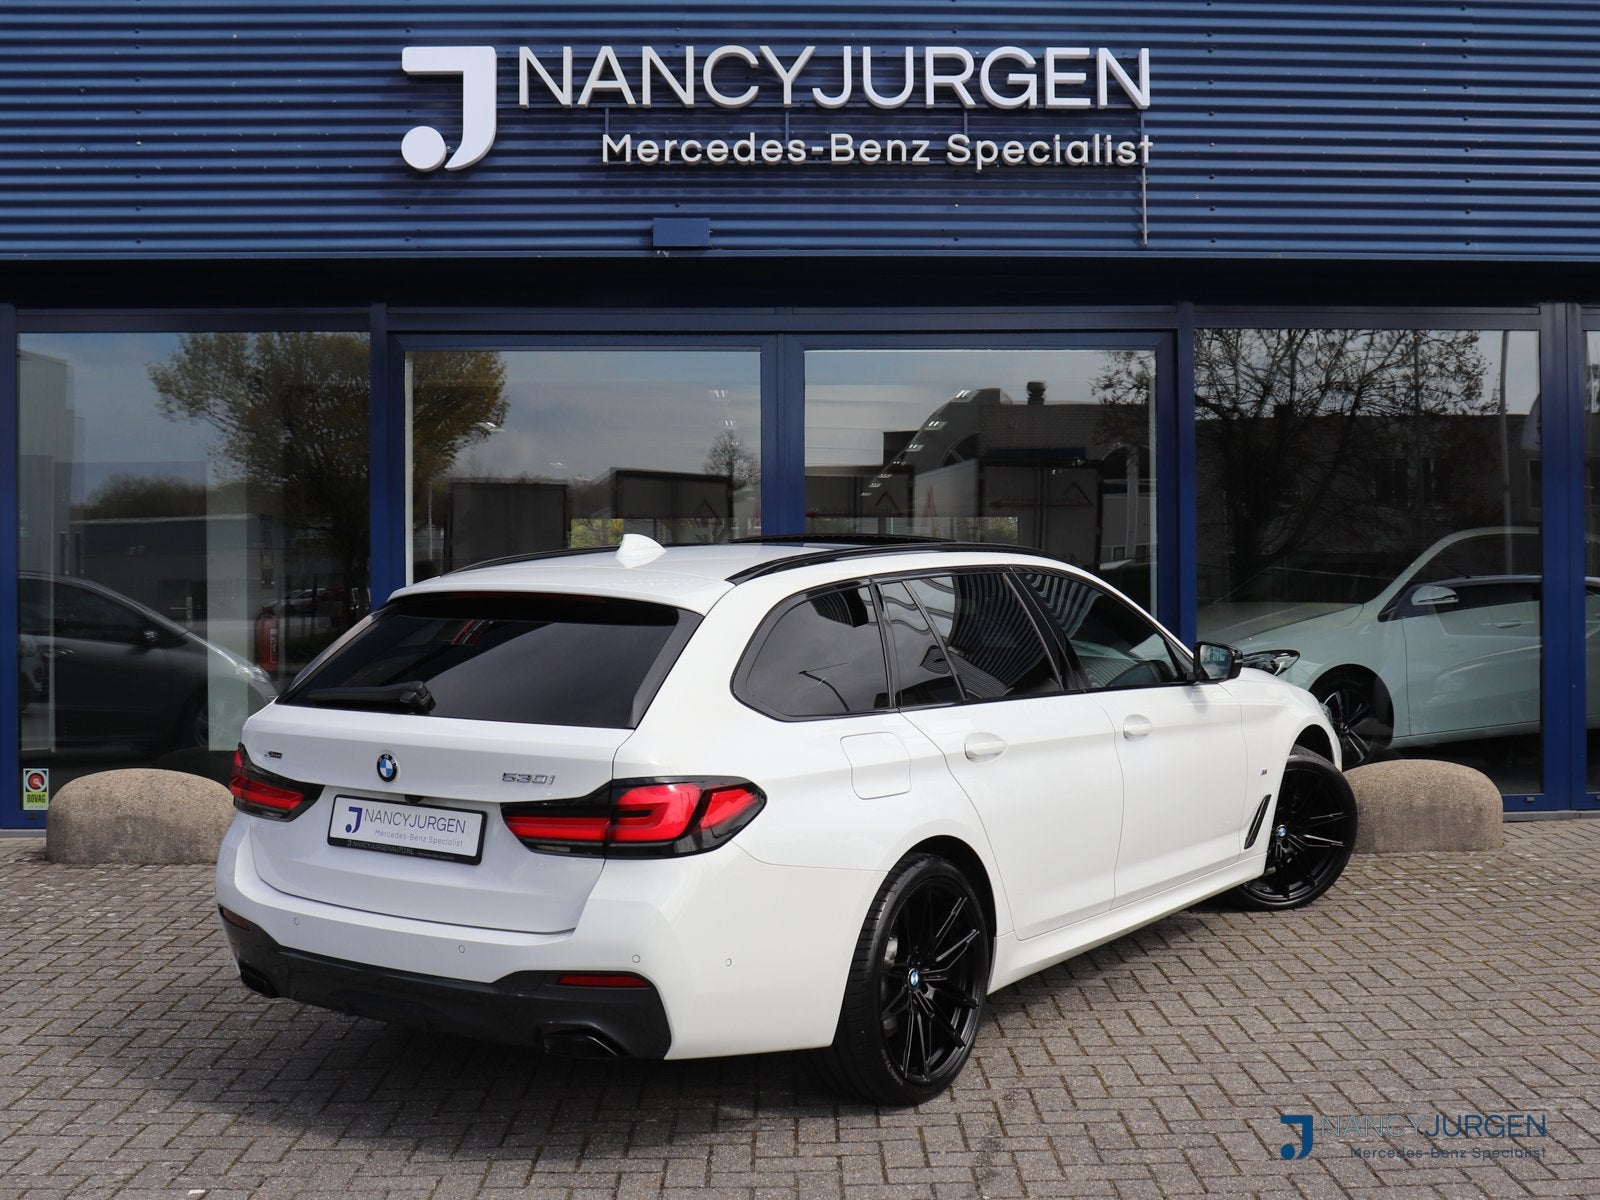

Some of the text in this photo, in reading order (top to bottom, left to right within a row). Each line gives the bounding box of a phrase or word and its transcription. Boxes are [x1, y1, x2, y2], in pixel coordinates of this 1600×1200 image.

[518, 44, 1151, 109] NANCYJURGEN
[602, 132, 1154, 172] Mercedes-Benz Specialist
[501, 772, 556, 785] 530i
[27, 794, 46, 803] BOVAG
[364, 808, 466, 834] NANCYJURGEN
[374, 829, 464, 848] Mercedes-Benz Specialist
